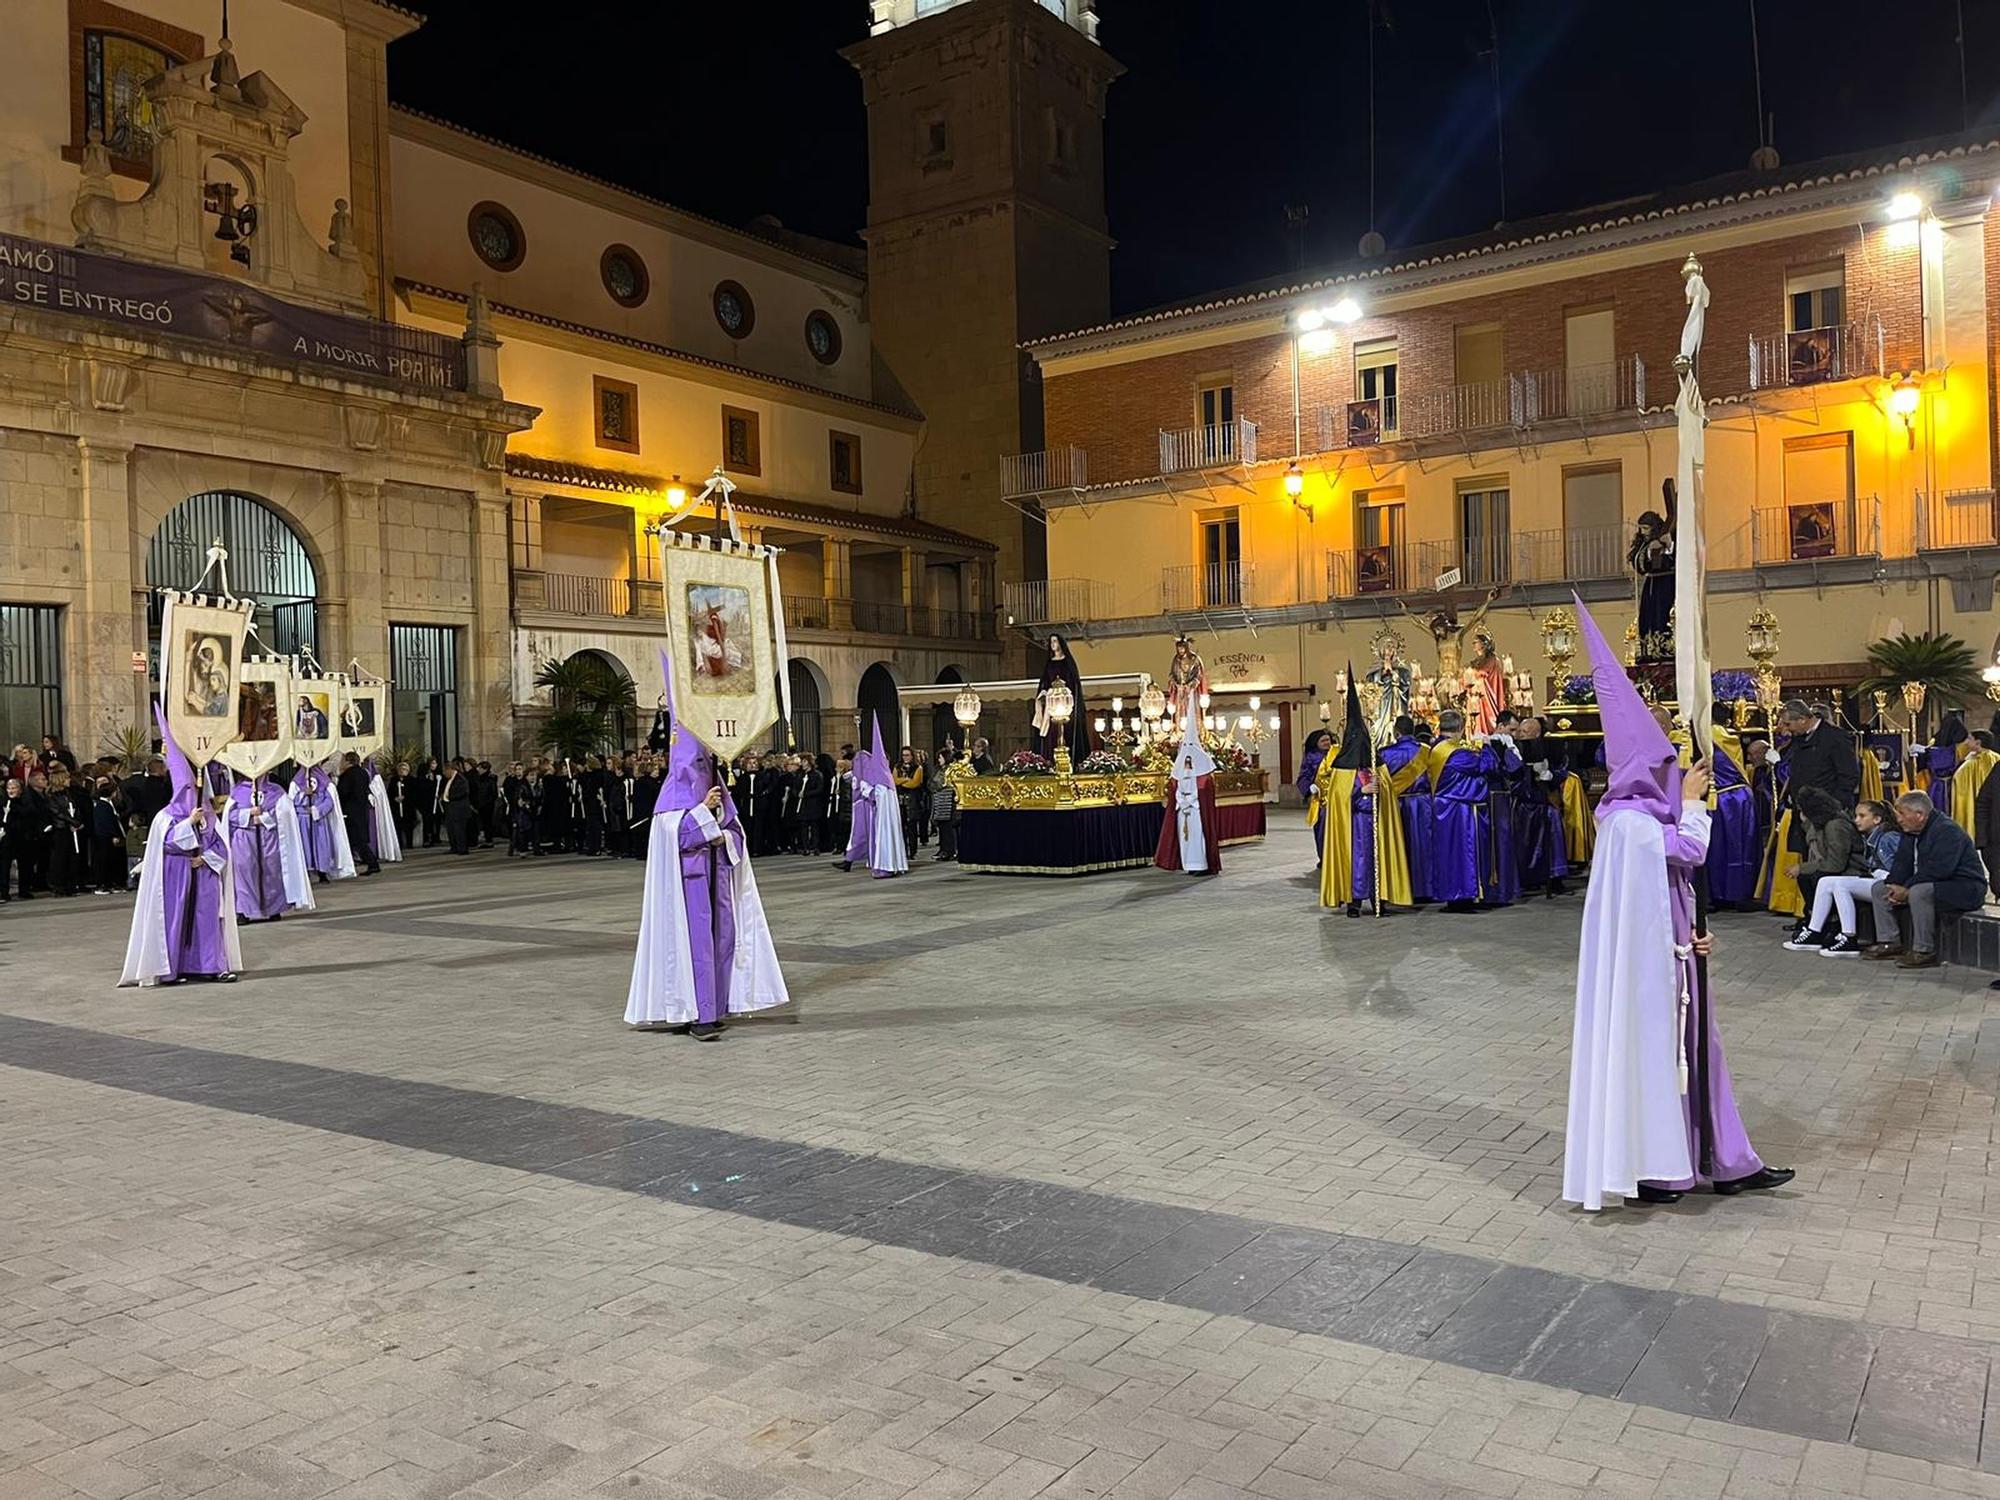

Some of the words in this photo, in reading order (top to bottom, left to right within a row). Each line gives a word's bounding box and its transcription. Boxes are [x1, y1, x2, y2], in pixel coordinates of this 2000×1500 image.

[0, 246, 55, 273] AMÓ
[15, 281, 48, 304] SE
[59, 288, 173, 324] ENTREGÓ
[293, 336, 308, 354] A
[315, 341, 380, 369] MORIR
[387, 356, 424, 383] POR
[430, 364, 454, 388] MÍ
[716, 719, 737, 738] III
[197, 736, 212, 751] IV
[249, 755, 258, 765] V
[303, 750, 314, 759] VI
